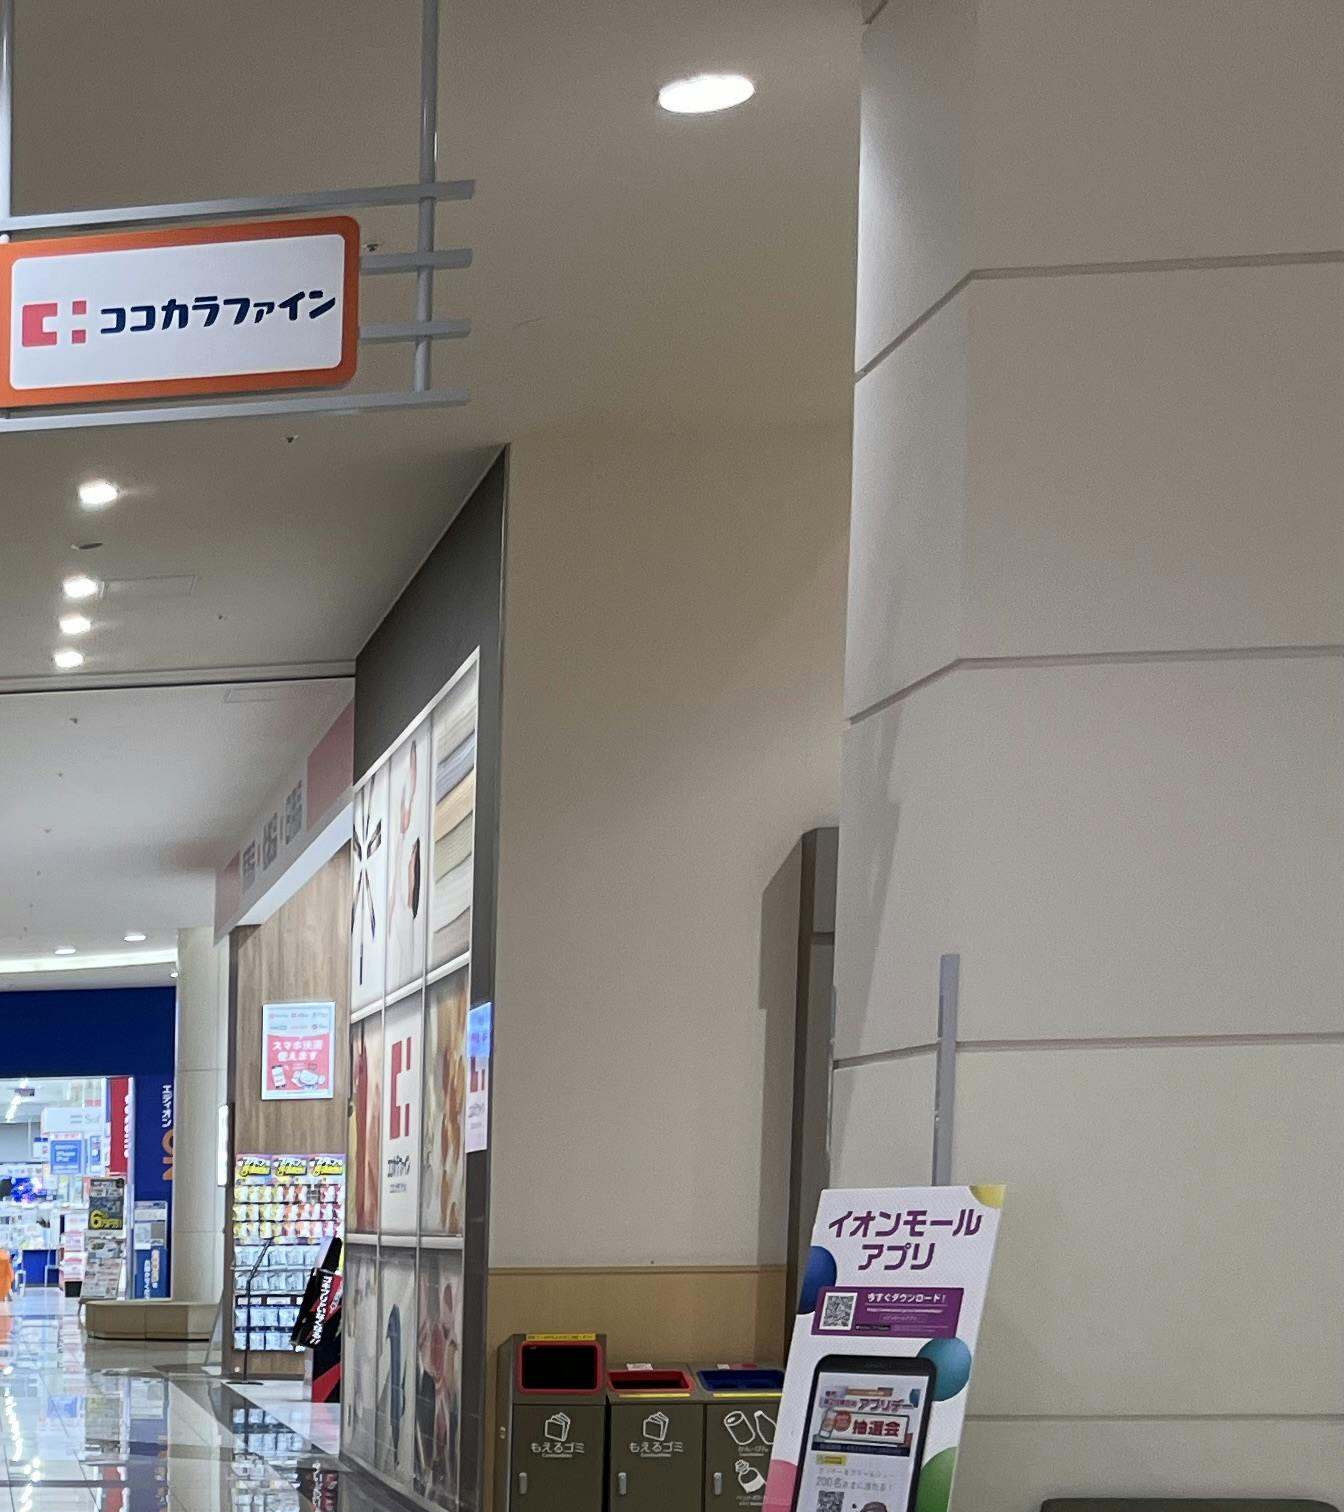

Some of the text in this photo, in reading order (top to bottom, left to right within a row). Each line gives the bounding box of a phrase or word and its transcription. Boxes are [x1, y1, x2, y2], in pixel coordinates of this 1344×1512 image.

[99, 290, 337, 336] ココカラファイン
[827, 1208, 983, 1239] イオンモール
[857, 1242, 937, 1271] アプリ
[530, 1441, 585, 1454] もえるゴミ
[629, 1441, 685, 1453] もえるゴミ
